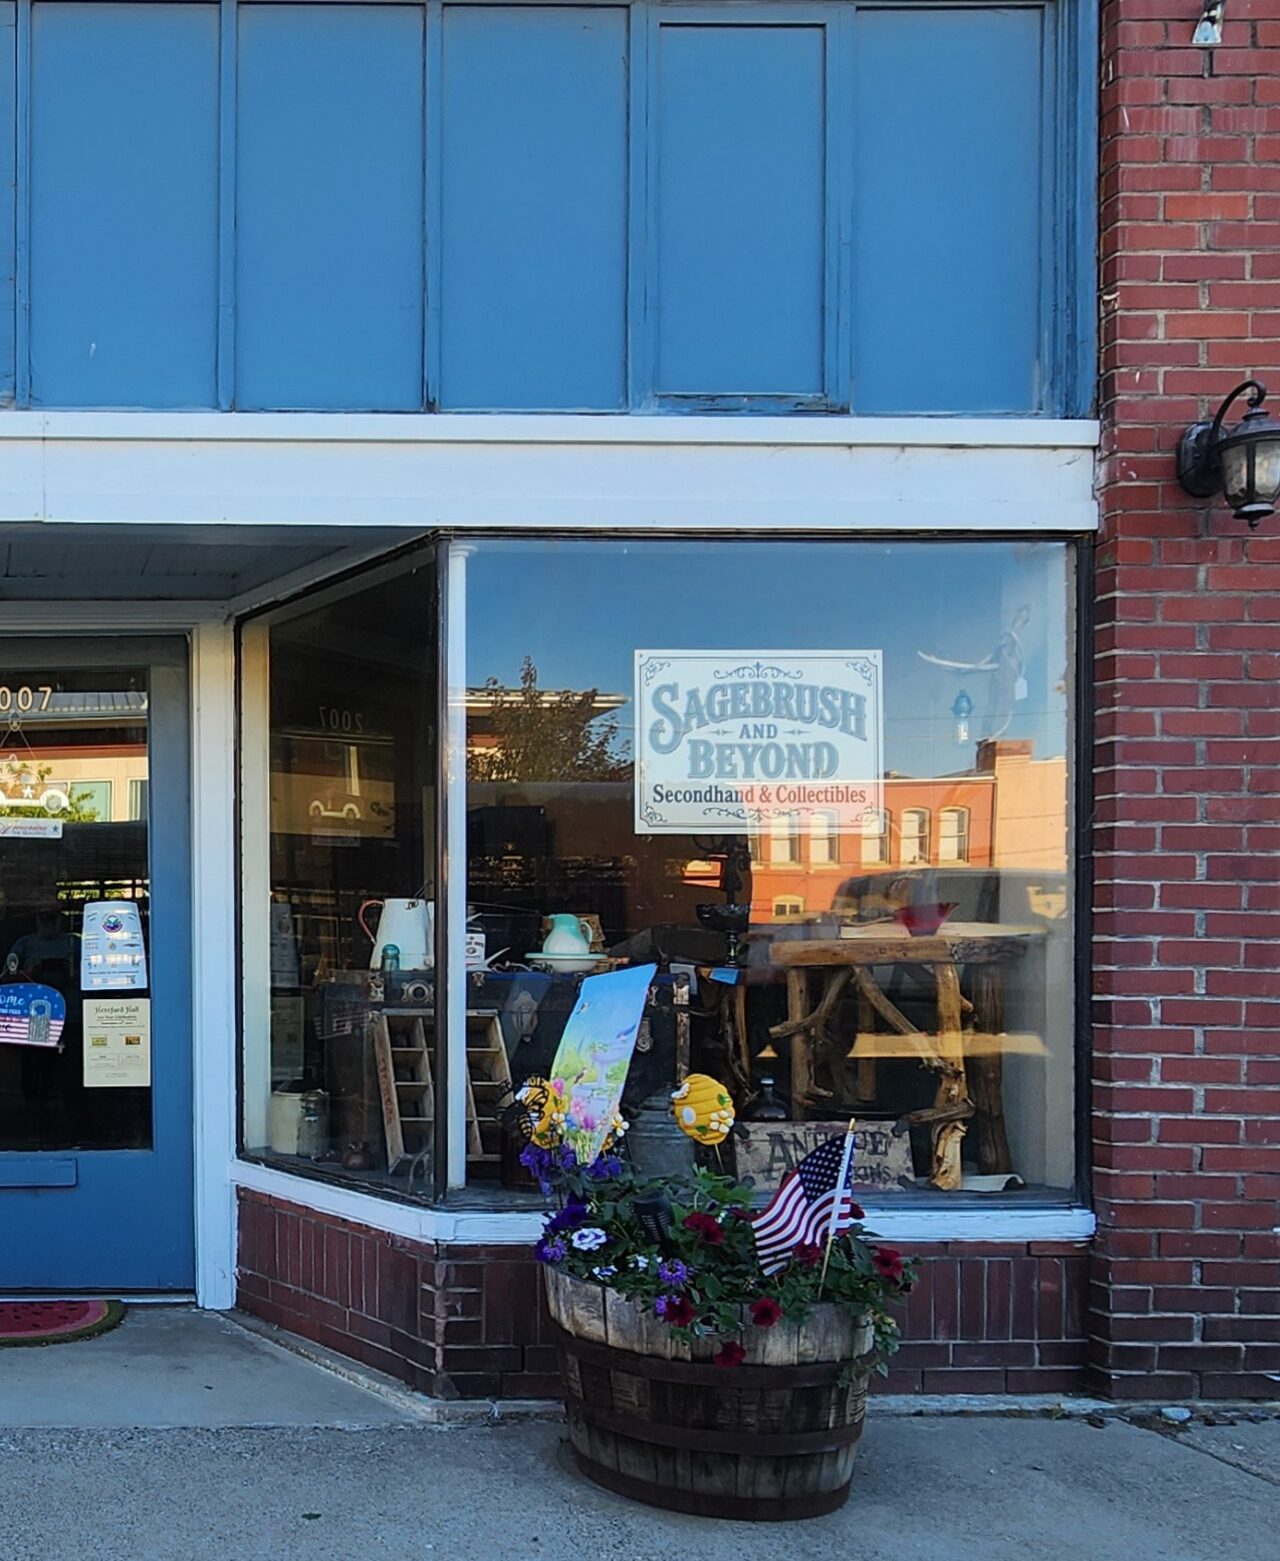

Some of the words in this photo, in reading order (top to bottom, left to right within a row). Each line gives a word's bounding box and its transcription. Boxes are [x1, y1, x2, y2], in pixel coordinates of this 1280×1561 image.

[648, 681, 867, 754] SAGEBRUSH
[739, 724, 778, 739] AND
[687, 739, 839, 779] BEYOND
[653, 784, 754, 804] Secondhand
[759, 786, 773, 803] &
[776, 784, 866, 804] Collectibles
